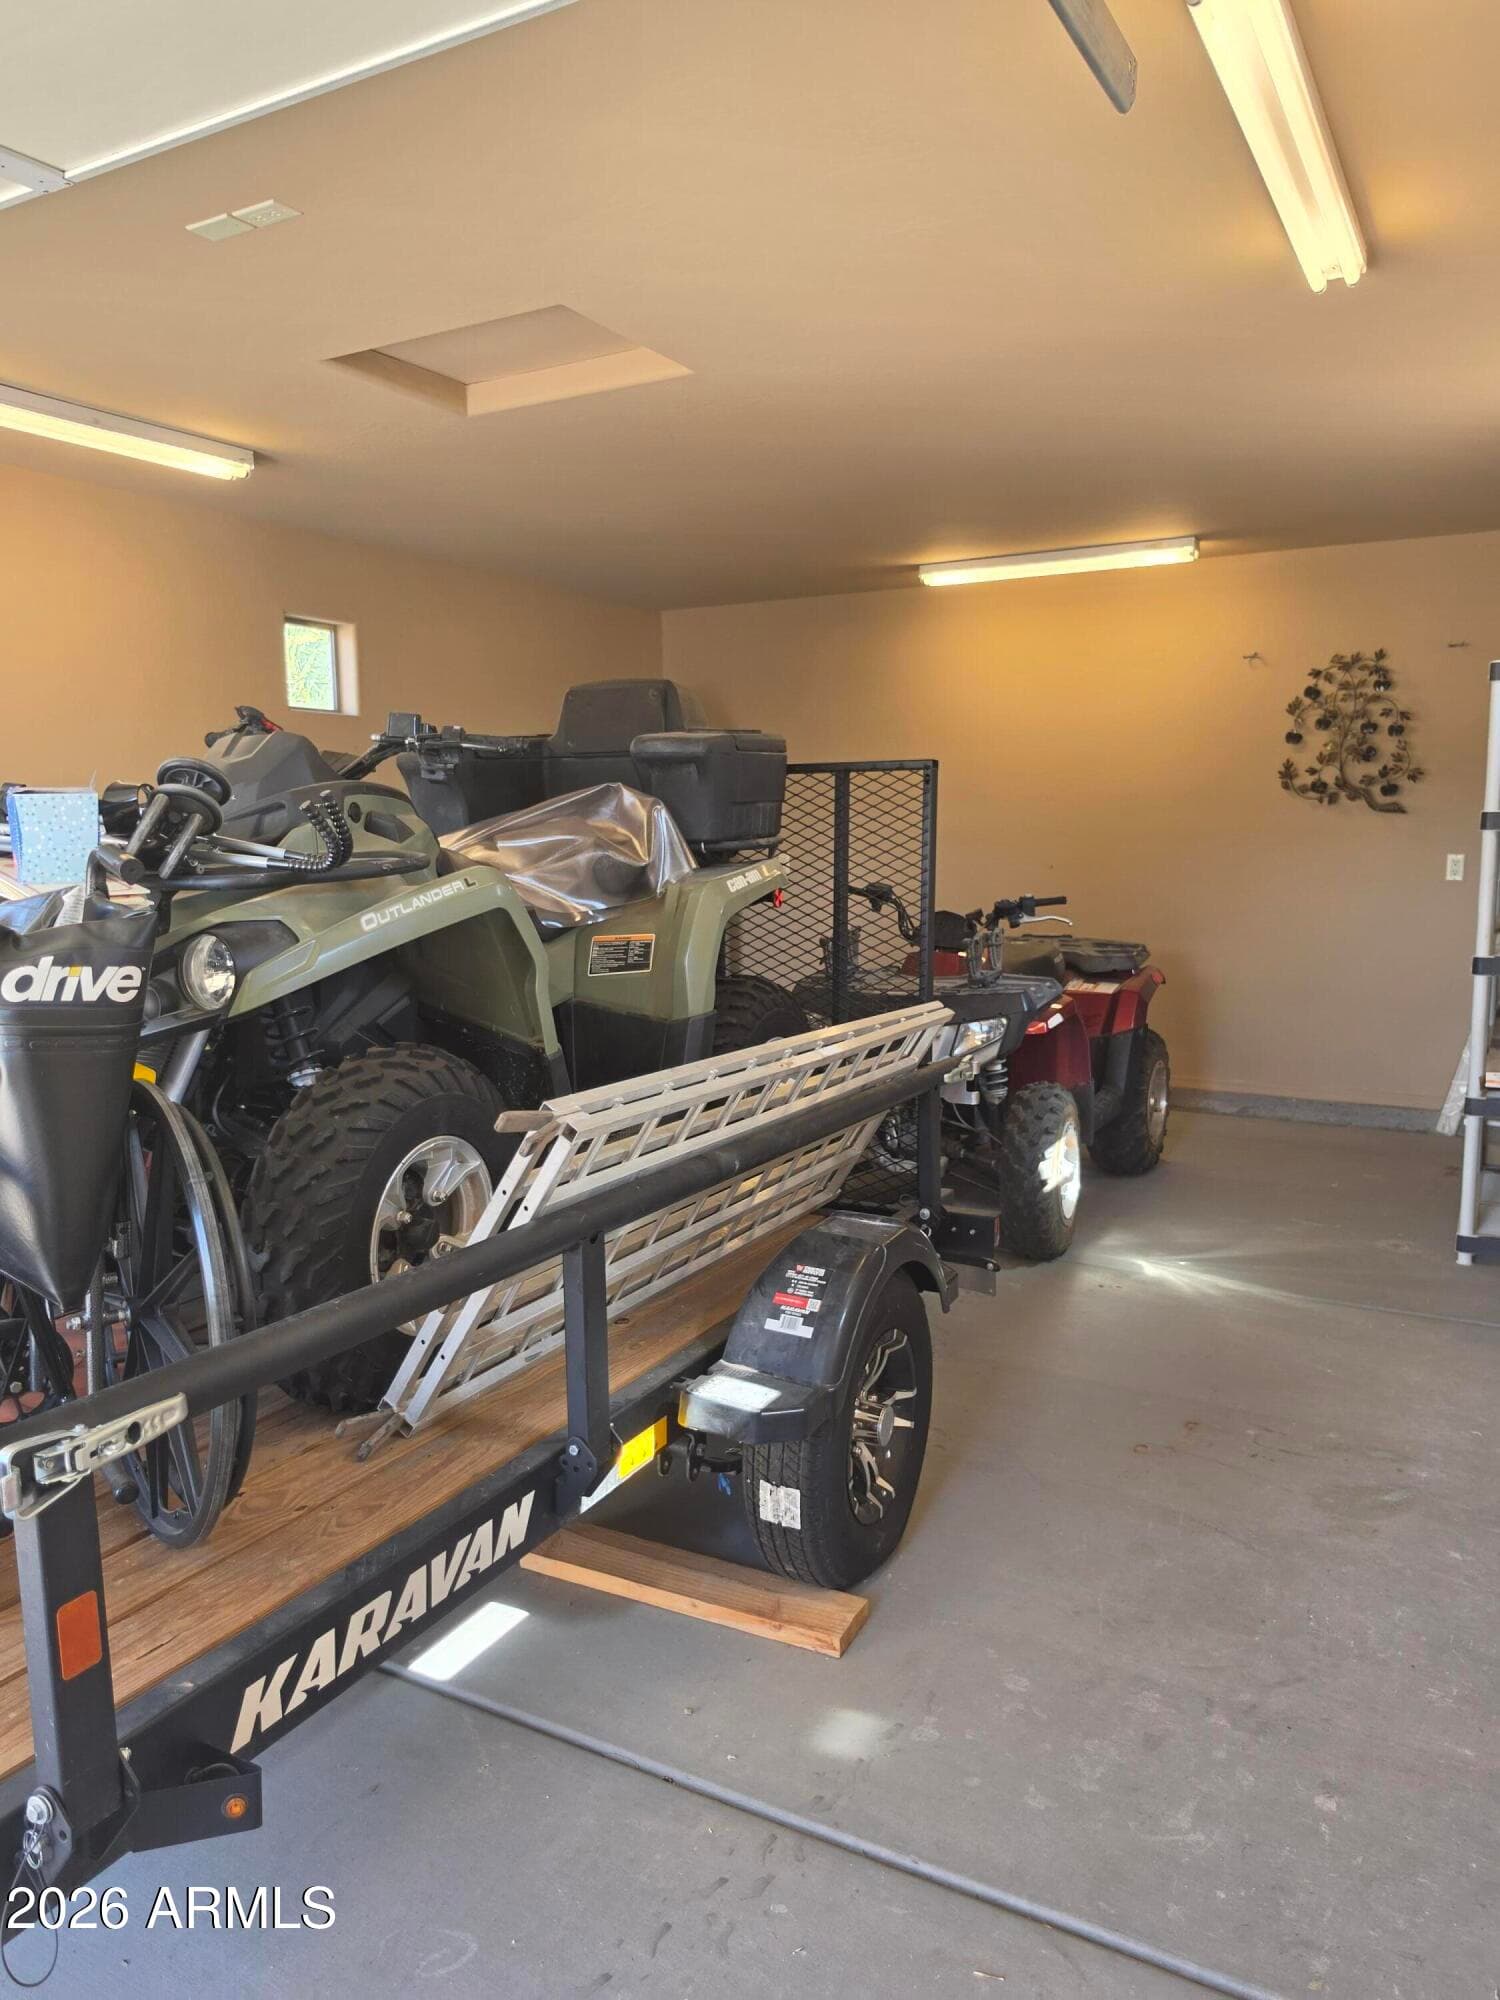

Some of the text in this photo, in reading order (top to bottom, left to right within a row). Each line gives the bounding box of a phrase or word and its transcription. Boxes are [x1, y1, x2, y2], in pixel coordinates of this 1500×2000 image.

[361, 880, 465, 931] OUTLANDER
[1, 955, 142, 1002] drive
[229, 1489, 536, 1755] KARAVAN
